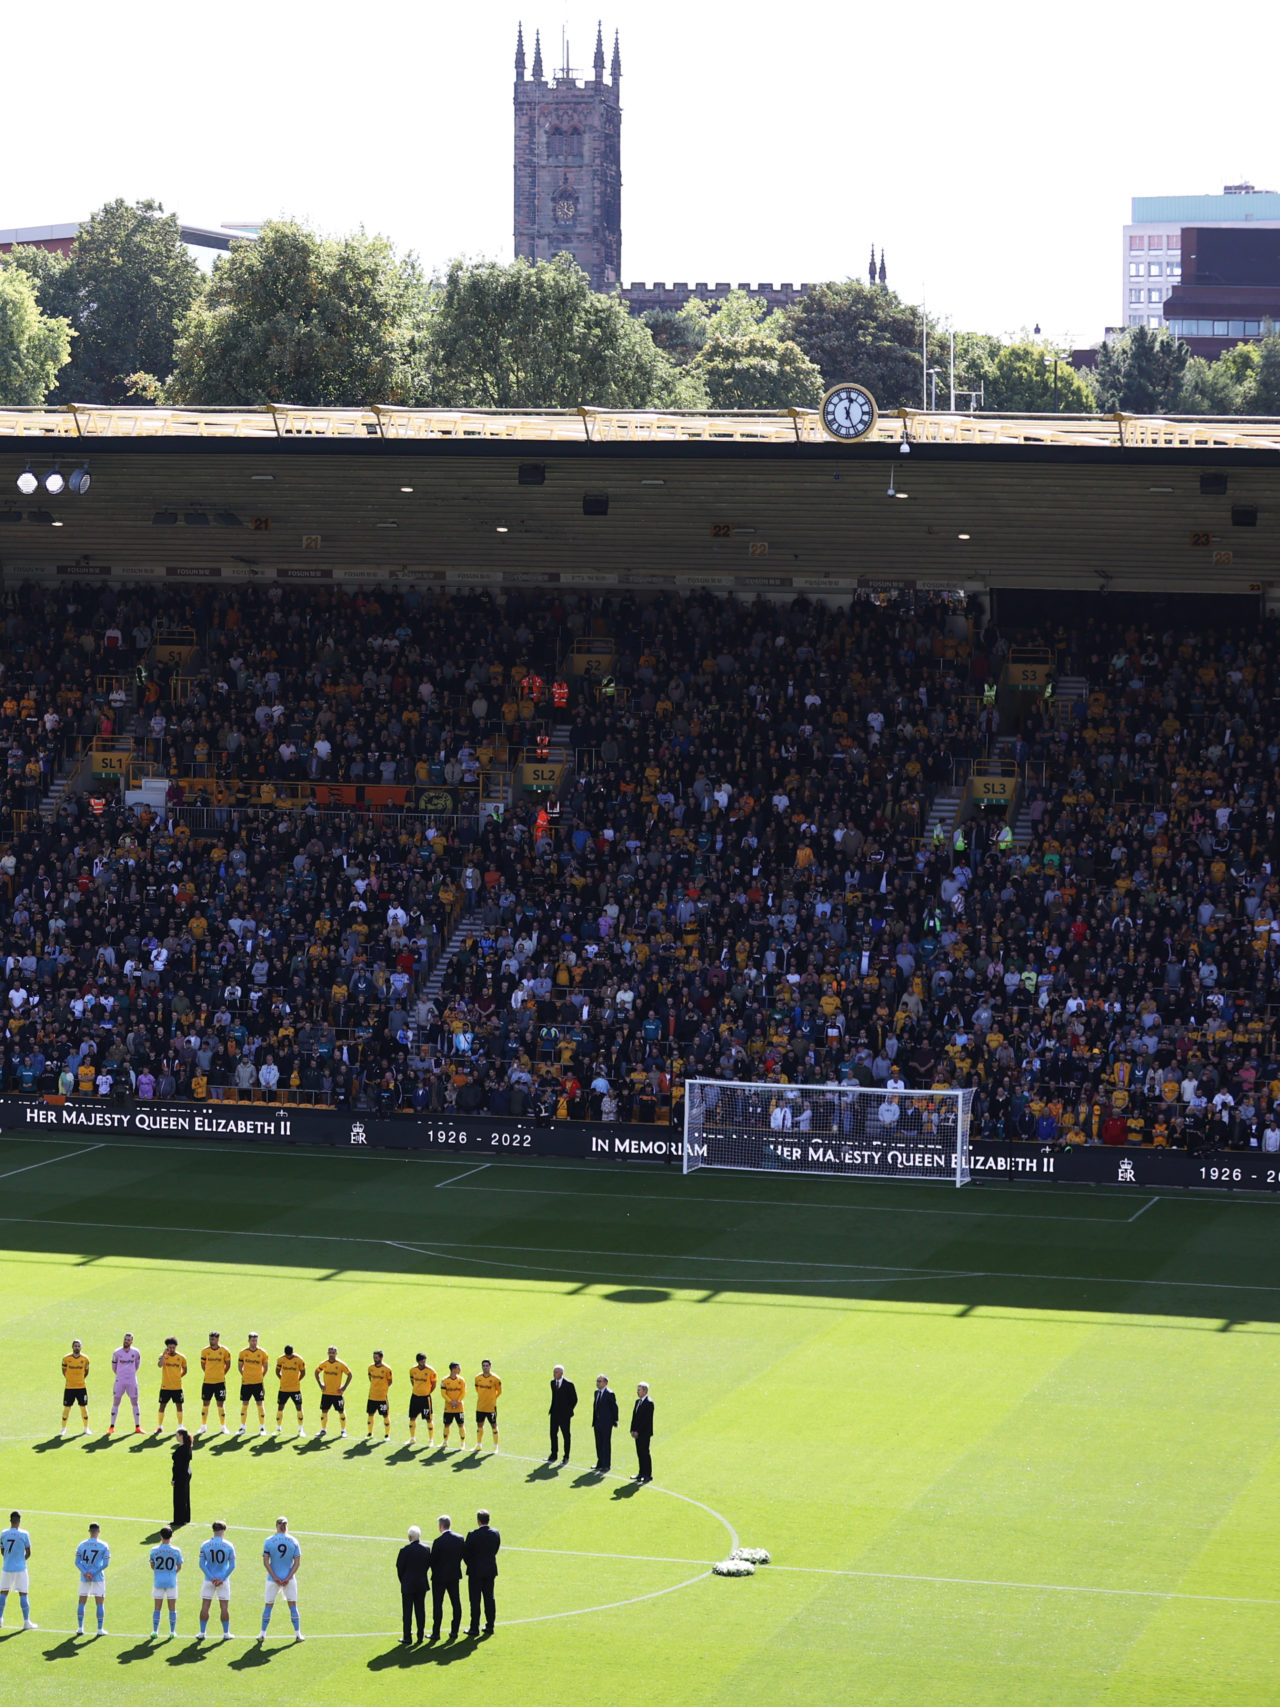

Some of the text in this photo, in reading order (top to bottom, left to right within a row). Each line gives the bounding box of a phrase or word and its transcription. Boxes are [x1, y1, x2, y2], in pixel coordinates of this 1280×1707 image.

[713, 525, 730, 537] 22
[751, 543, 767, 557] 22
[169, 651, 183, 662] S1
[586, 660, 601, 671] S2
[1022, 670, 1037, 681] S3
[102, 758, 122, 769] SL1
[533, 770, 555, 781] SL2
[984, 783, 1006, 794] SL3
[25, 1108, 291, 1136] HER MAJESTY QUEEN ELIZABETH II
[428, 1130, 468, 1144] 1926
[490, 1133, 532, 1147] 2022
[591, 1137, 708, 1157] IN MEMORIAM
[770, 1144, 801, 1160] HER
[887, 1151, 945, 1168] QUEEN
[951, 1156, 1037, 1172] ELIZABETH
[1043, 1157, 1054, 1172] II
[1200, 1167, 1241, 1181] 1926
[7, 1539, 16, 1554] 7
[277, 1543, 287, 1559] 9
[82, 1549, 99, 1564] 47
[155, 1556, 175, 1571] 20
[209, 1549, 226, 1564] 10
